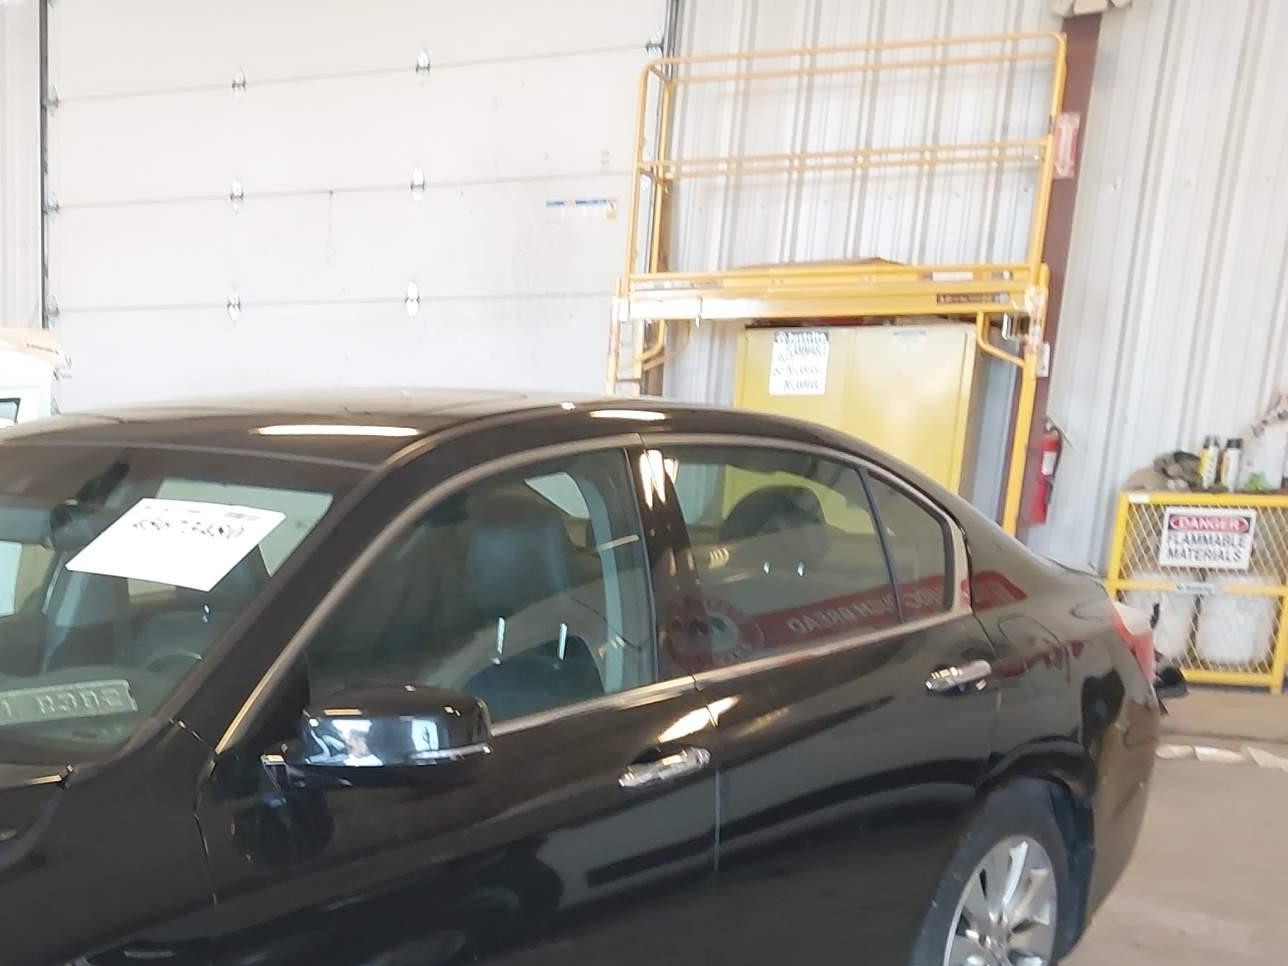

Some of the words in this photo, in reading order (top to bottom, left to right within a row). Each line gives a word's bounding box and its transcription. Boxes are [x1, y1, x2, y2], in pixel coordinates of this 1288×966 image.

[1178, 515, 1240, 531] DANGER
[1168, 532, 1244, 547] FLAMMABLE
[1168, 546, 1242, 561] MATERIALS
